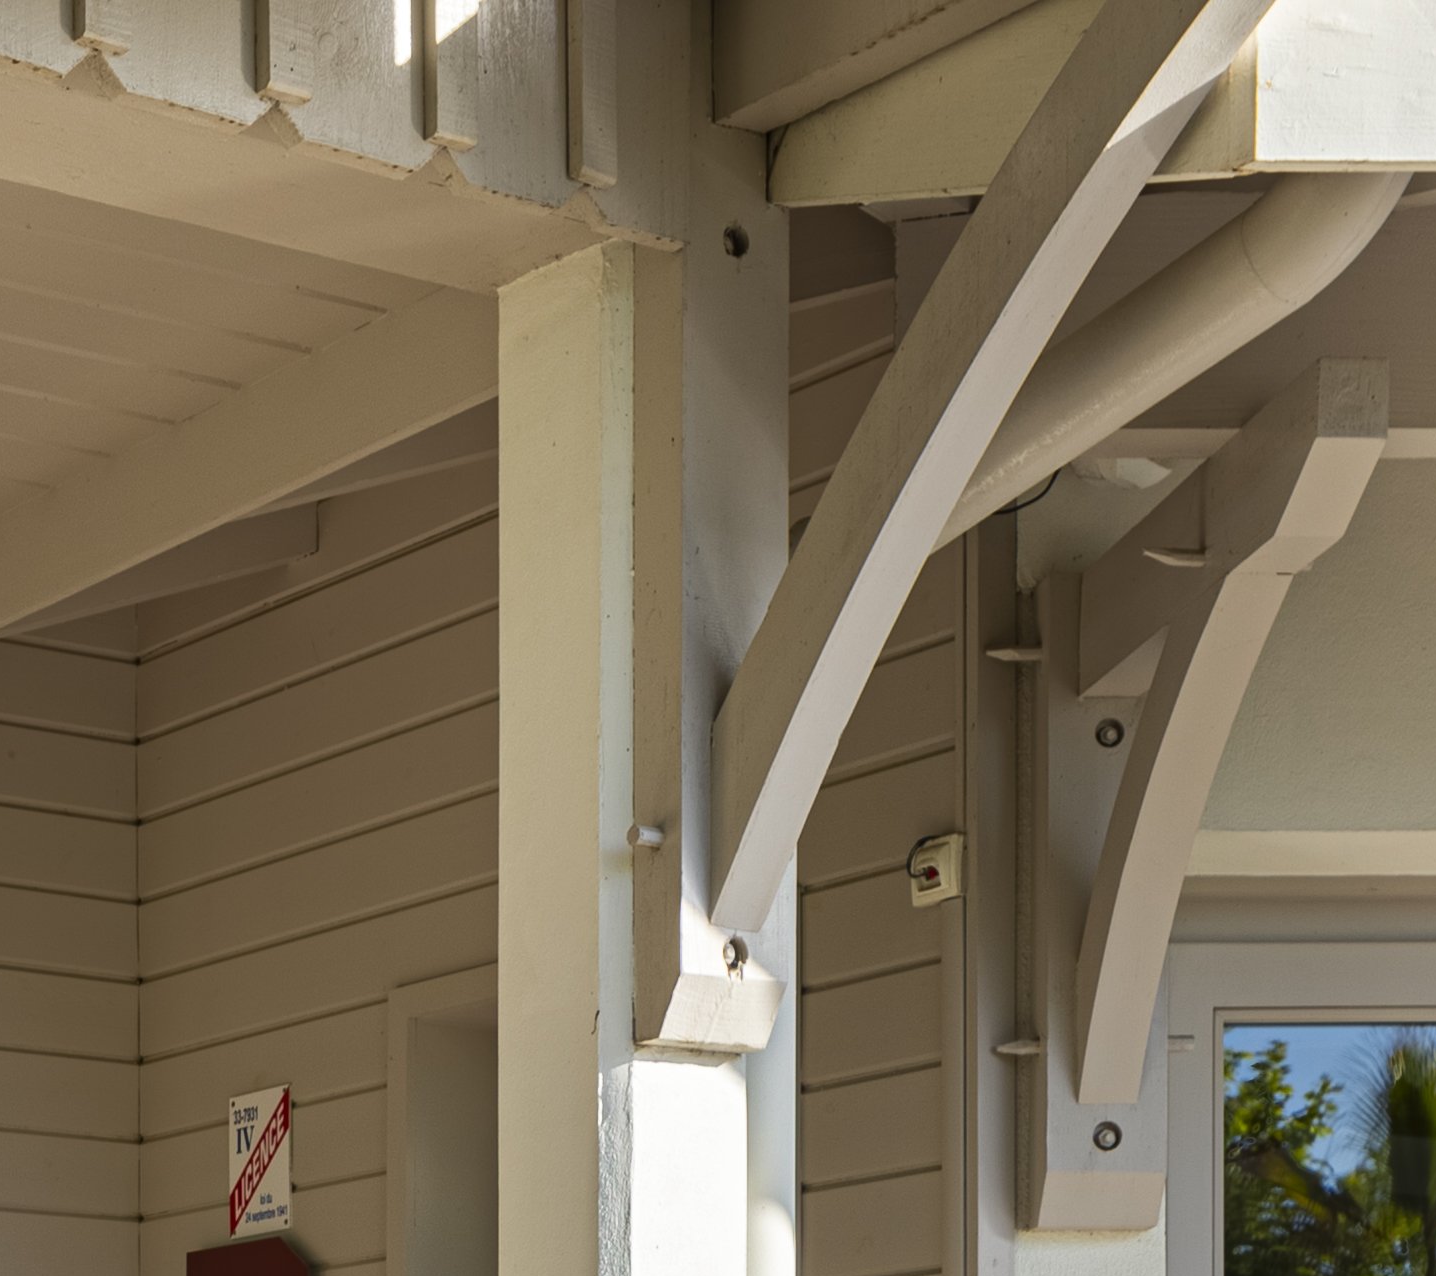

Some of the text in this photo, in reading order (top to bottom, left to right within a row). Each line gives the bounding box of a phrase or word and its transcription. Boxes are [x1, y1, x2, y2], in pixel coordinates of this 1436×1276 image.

[233, 1106, 258, 1126] 33-7931
[236, 1125, 255, 1154] IV
[234, 1102, 285, 1222] LICENCE
[252, 1207, 276, 1223] septembre
